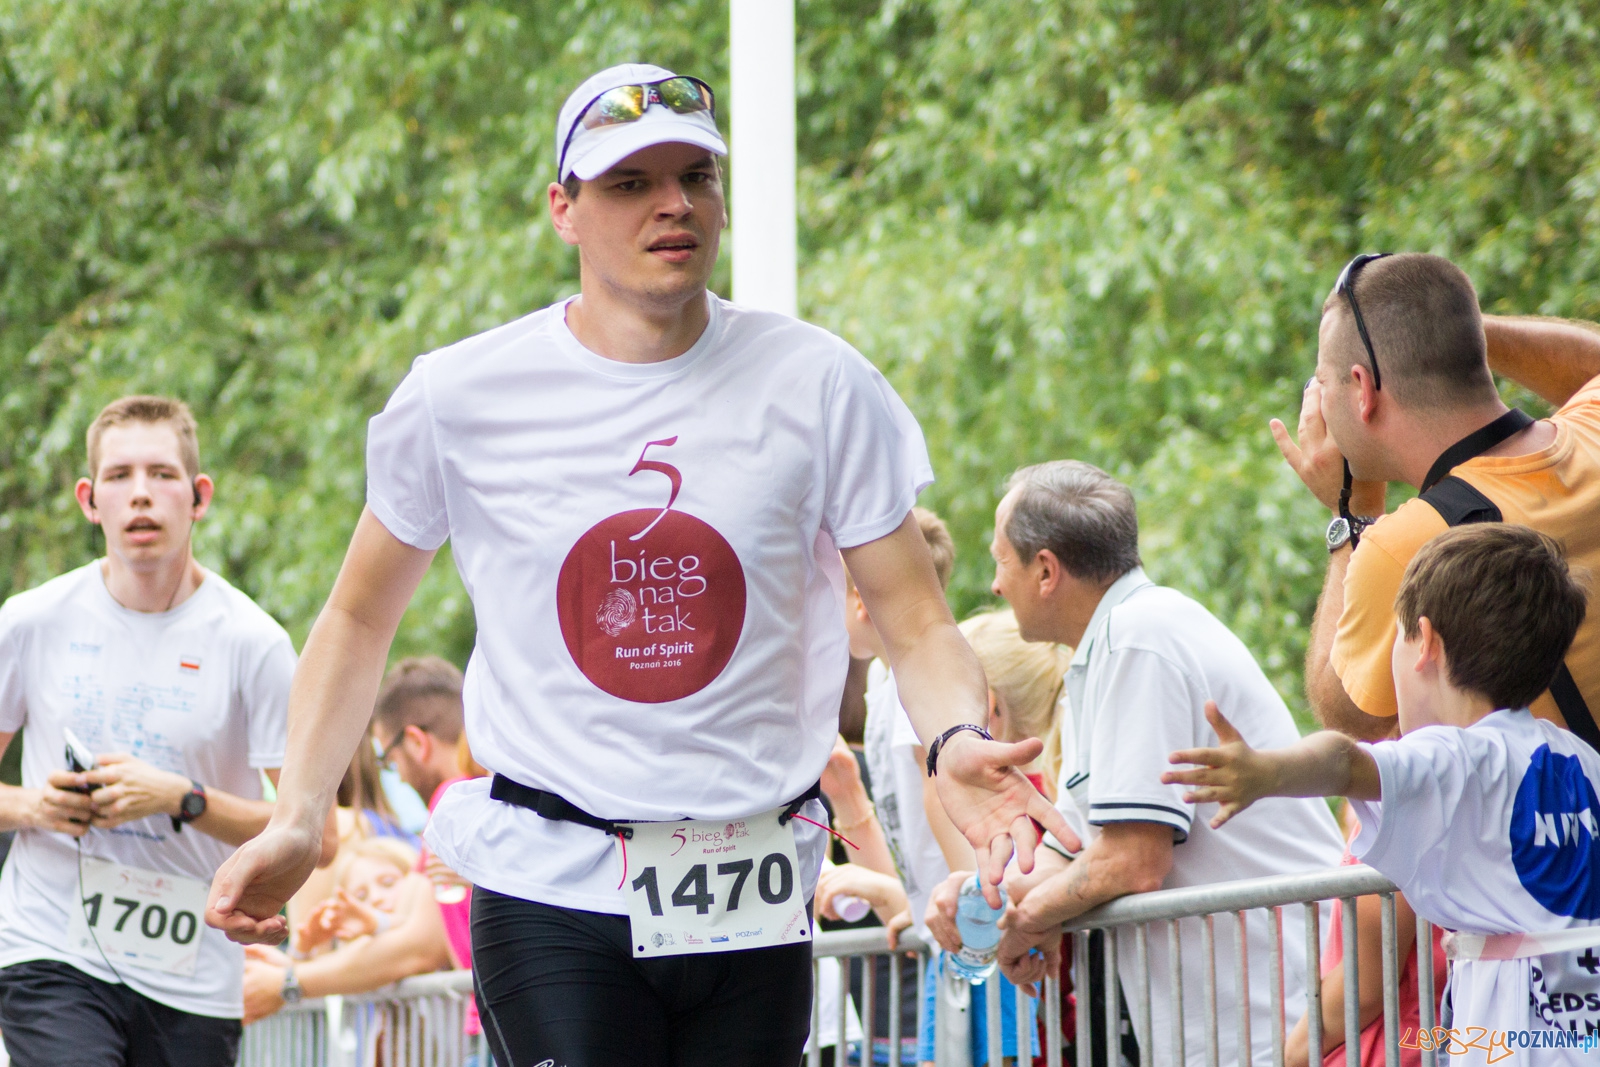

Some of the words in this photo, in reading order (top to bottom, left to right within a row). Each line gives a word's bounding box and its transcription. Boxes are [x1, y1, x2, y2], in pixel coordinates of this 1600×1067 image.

[628, 435, 682, 541] 5
[610, 540, 707, 597] bieg
[639, 586, 674, 605] na
[641, 605, 695, 634] tak
[615, 646, 640, 659] Run
[643, 643, 657, 657] of
[659, 641, 694, 658] Spirit
[629, 659, 661, 670] Poznań
[663, 658, 682, 668] 2016
[670, 827, 687, 857] 5
[692, 827, 724, 847] bieg
[735, 827, 750, 838] tak
[722, 844, 736, 853] Spirit
[631, 852, 794, 917] 1470
[82, 892, 197, 945] 1700
